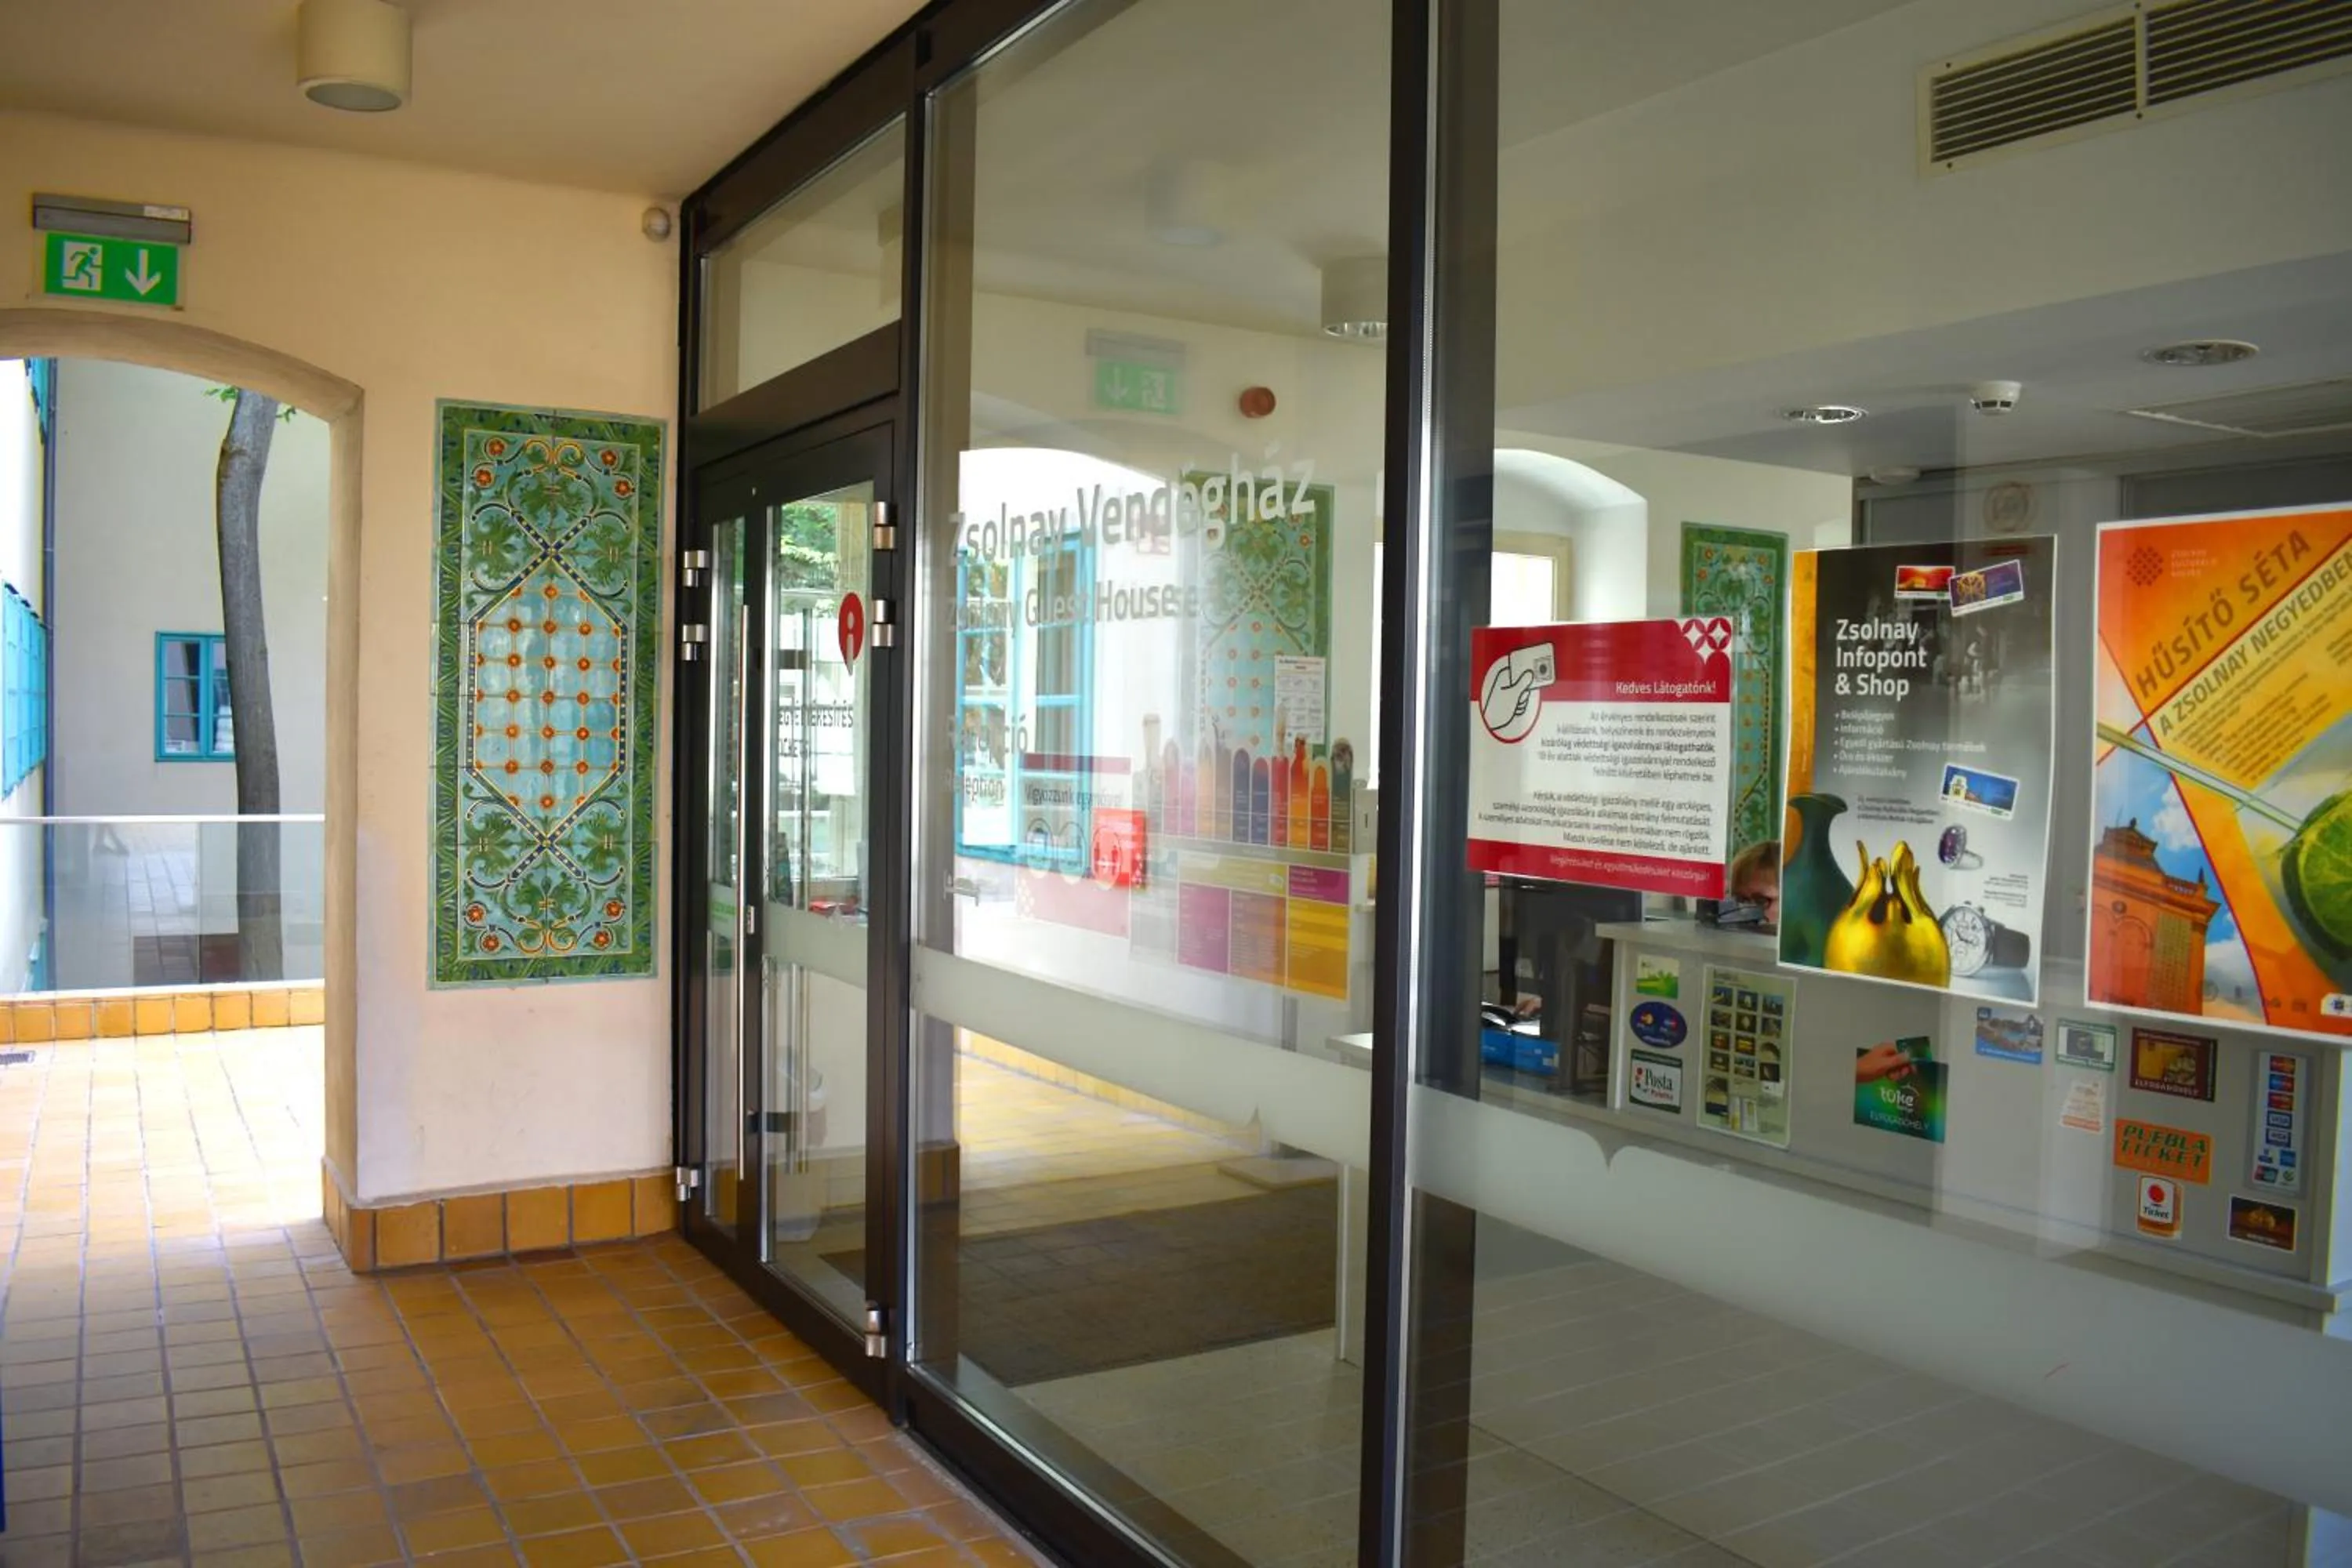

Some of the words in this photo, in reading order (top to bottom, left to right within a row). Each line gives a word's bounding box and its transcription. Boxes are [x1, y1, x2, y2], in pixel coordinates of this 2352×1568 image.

[948, 502, 1067, 572] Zsolnay
[1076, 444, 1316, 550] Vendégház
[1025, 588, 1091, 627] Guest
[2136, 588, 2234, 699] HŰSÍTŐ
[2239, 530, 2313, 604] SÉTA
[1835, 617, 1919, 644] Zsolnay
[1835, 646, 1927, 673] Infopont
[1615, 681, 1652, 695] Kedves
[1653, 680, 1717, 698] Látogatónk!
[1835, 674, 1851, 695] &
[1856, 672, 1910, 701] Shop
[2160, 715, 2173, 736] A
[2172, 643, 2251, 723] ZSOLNAY
[1645, 1067, 1673, 1091] Posta
[2122, 1138, 2202, 1167] TICKET
[2143, 1205, 2170, 1219] Ticket
